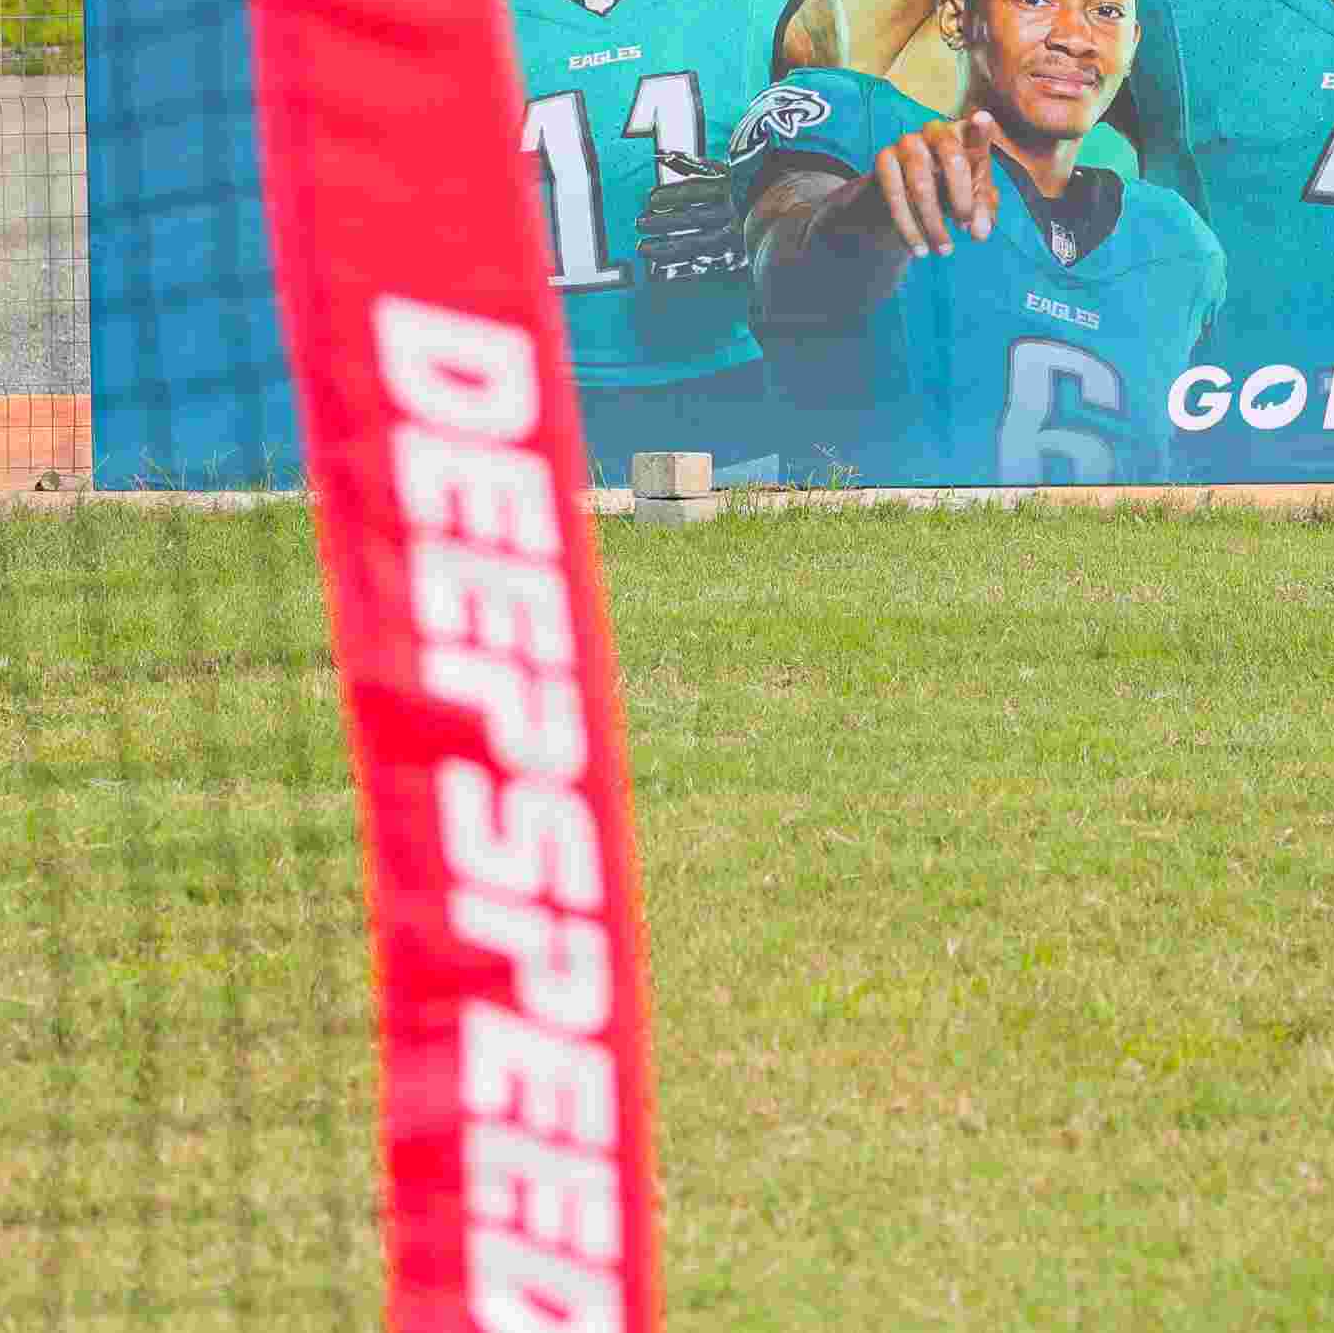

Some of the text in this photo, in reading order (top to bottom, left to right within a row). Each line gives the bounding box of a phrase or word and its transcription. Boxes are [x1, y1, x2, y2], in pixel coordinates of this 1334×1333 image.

[568, 44, 643, 70] EAGLES
[1026, 290, 1100, 330] EAGLES
[1167, 364, 1308, 431] GO
[369, 292, 626, 1333] DEEPSPEED
